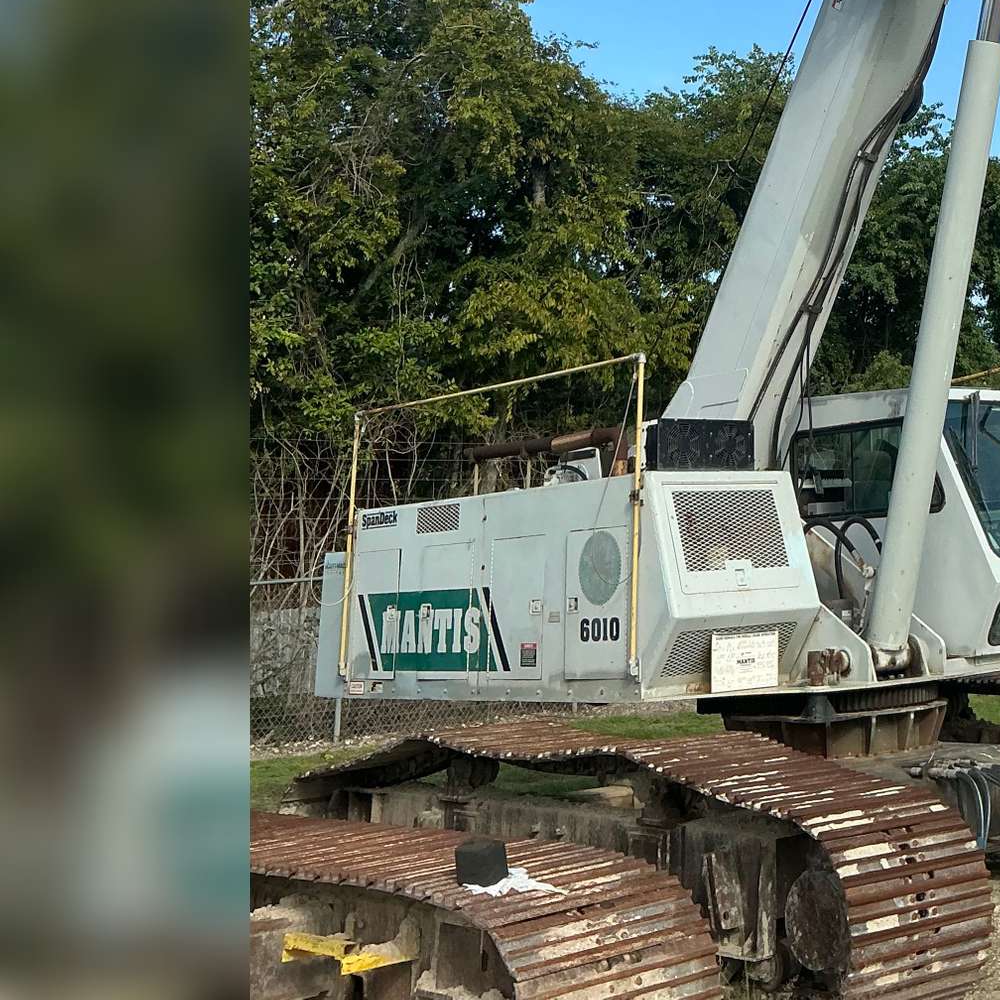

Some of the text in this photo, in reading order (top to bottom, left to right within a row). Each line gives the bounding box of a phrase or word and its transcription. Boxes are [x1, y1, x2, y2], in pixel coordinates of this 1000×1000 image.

[361, 510, 398, 529] SpanDeck
[380, 607, 480, 654] MANTIS
[580, 617, 620, 642] 6010
